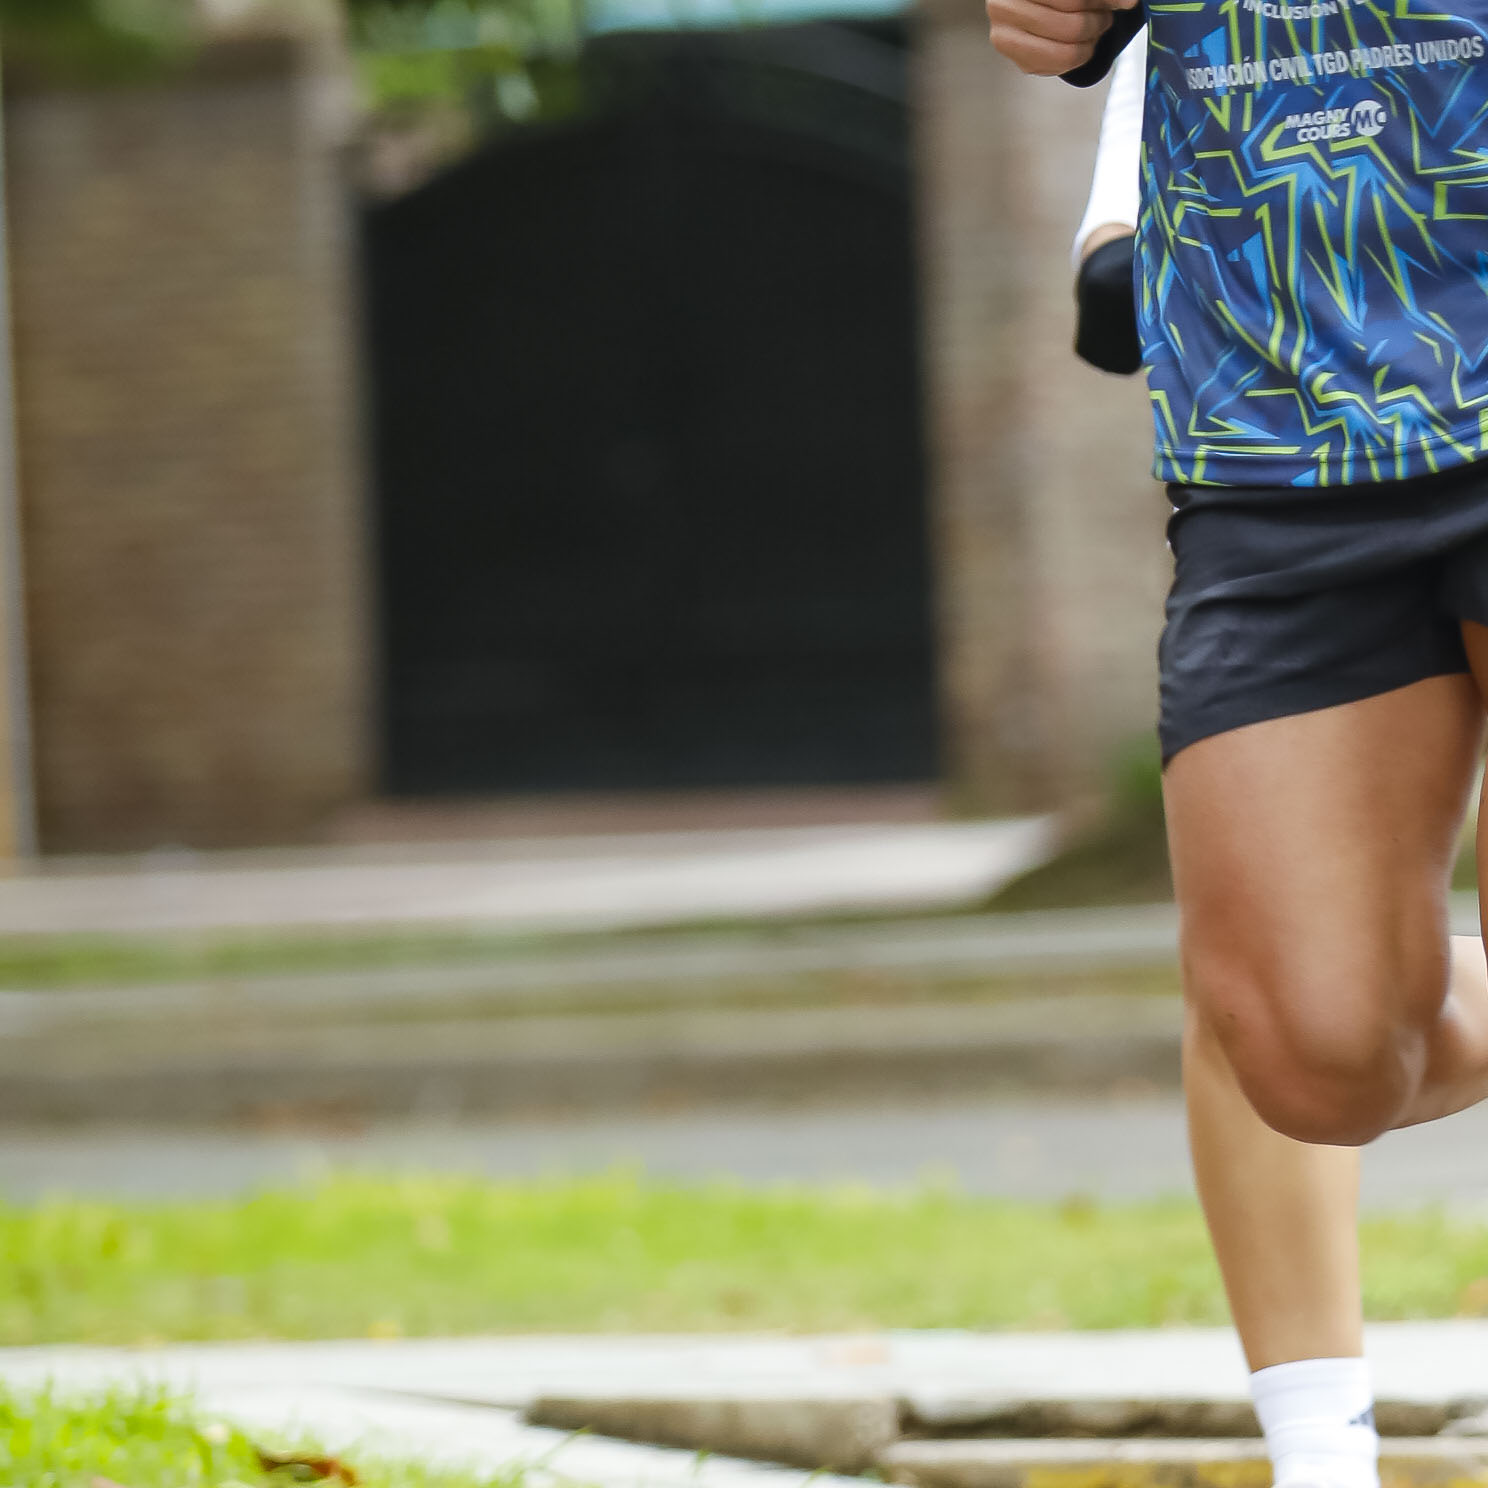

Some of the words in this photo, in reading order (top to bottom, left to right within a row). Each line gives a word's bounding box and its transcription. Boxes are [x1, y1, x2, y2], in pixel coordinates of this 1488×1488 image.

[1184, 55, 1268, 90] SOCIACIÓN
[1269, 56, 1312, 82] CIVIL
[1312, 50, 1349, 76] TGD
[1349, 43, 1415, 71] PADRES
[1415, 35, 1485, 65] UNIDOS
[1284, 107, 1350, 129] MAGNY
[1296, 122, 1352, 143] COURS
